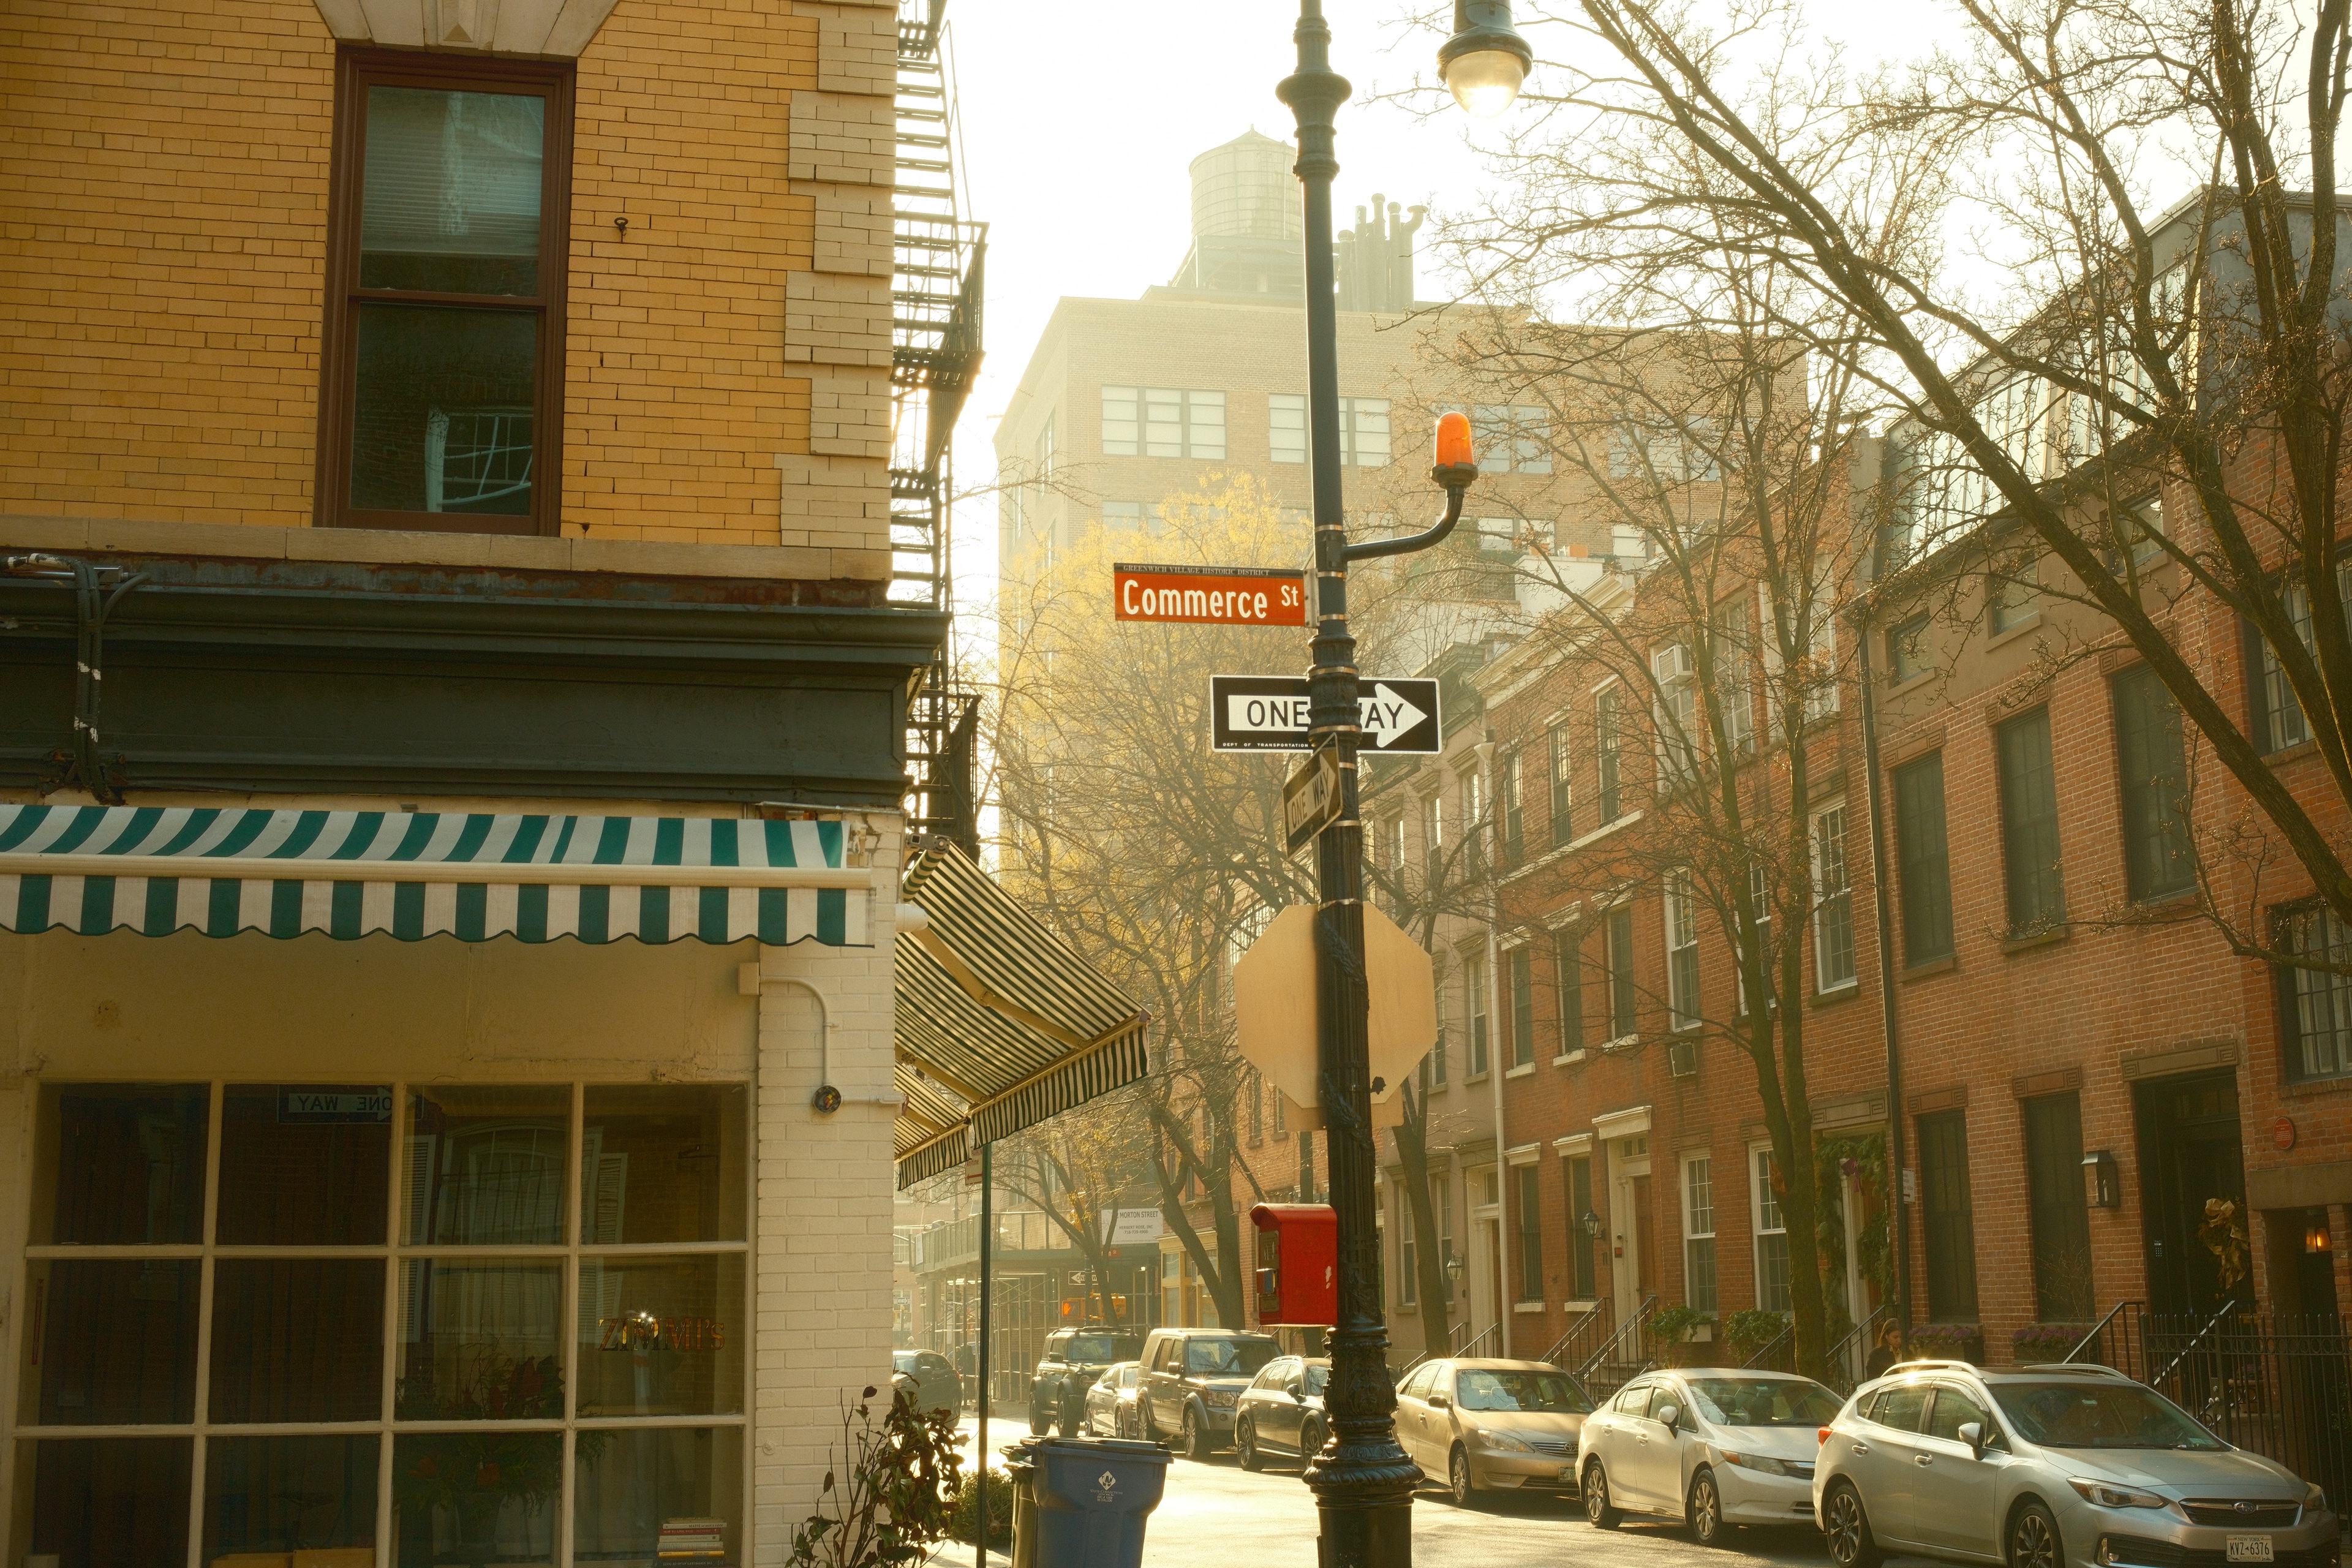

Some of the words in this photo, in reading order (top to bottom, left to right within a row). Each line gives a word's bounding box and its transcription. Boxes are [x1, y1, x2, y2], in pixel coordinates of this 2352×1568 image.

[1123, 579, 1267, 619] Commerce
[1281, 585, 1299, 606] St
[1246, 700, 1308, 727] ONE
[1358, 702, 1404, 729] AY
[1291, 791, 1308, 829] ONE
[1312, 767, 1329, 809] WAY
[2230, 1542, 2245, 1555] KVZ
[2250, 1542, 2269, 1555] 6376
